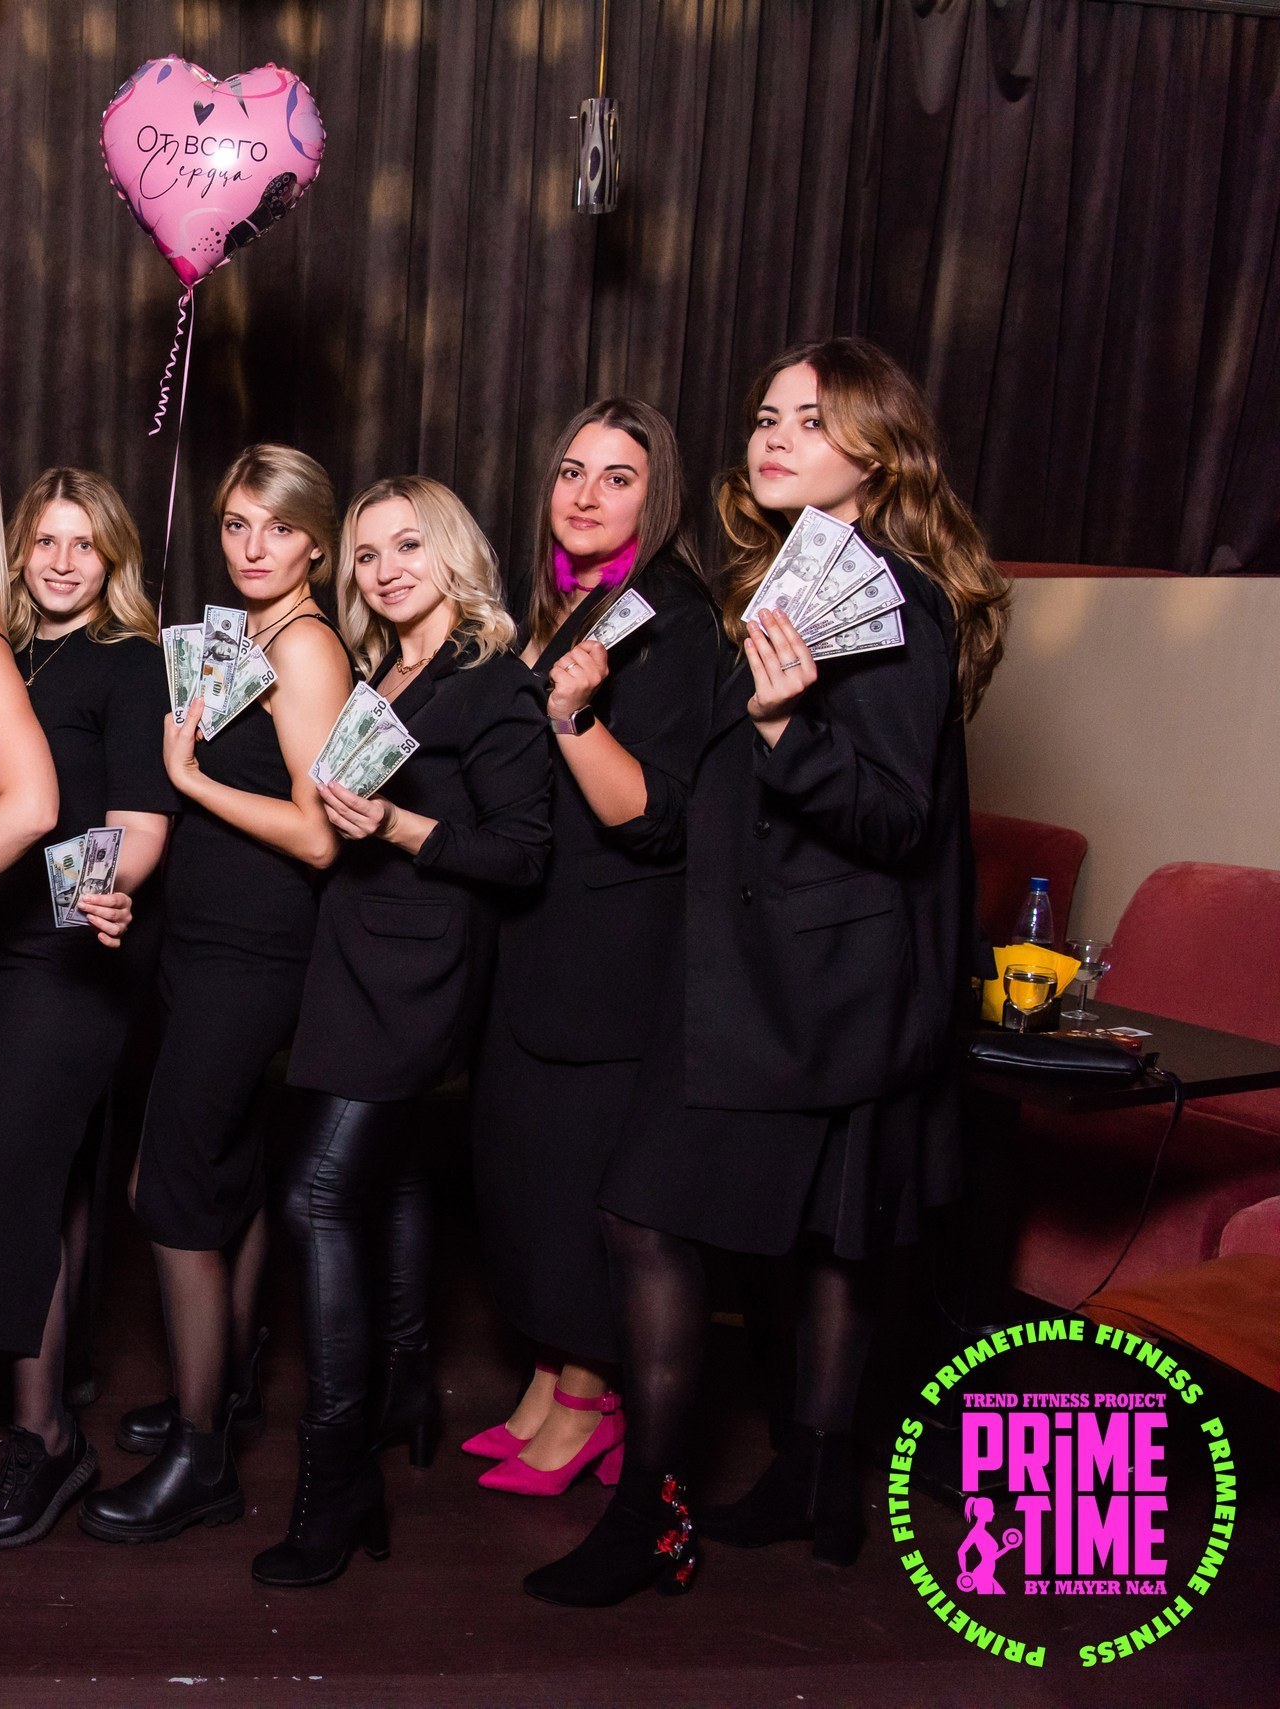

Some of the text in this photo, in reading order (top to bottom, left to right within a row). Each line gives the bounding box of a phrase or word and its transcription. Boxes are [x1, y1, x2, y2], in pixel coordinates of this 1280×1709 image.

[240, 639, 251, 655] 50
[261, 670, 275, 686] 50
[174, 709, 185, 725] 50
[373, 700, 387, 718] 50
[400, 738, 416, 754] 50
